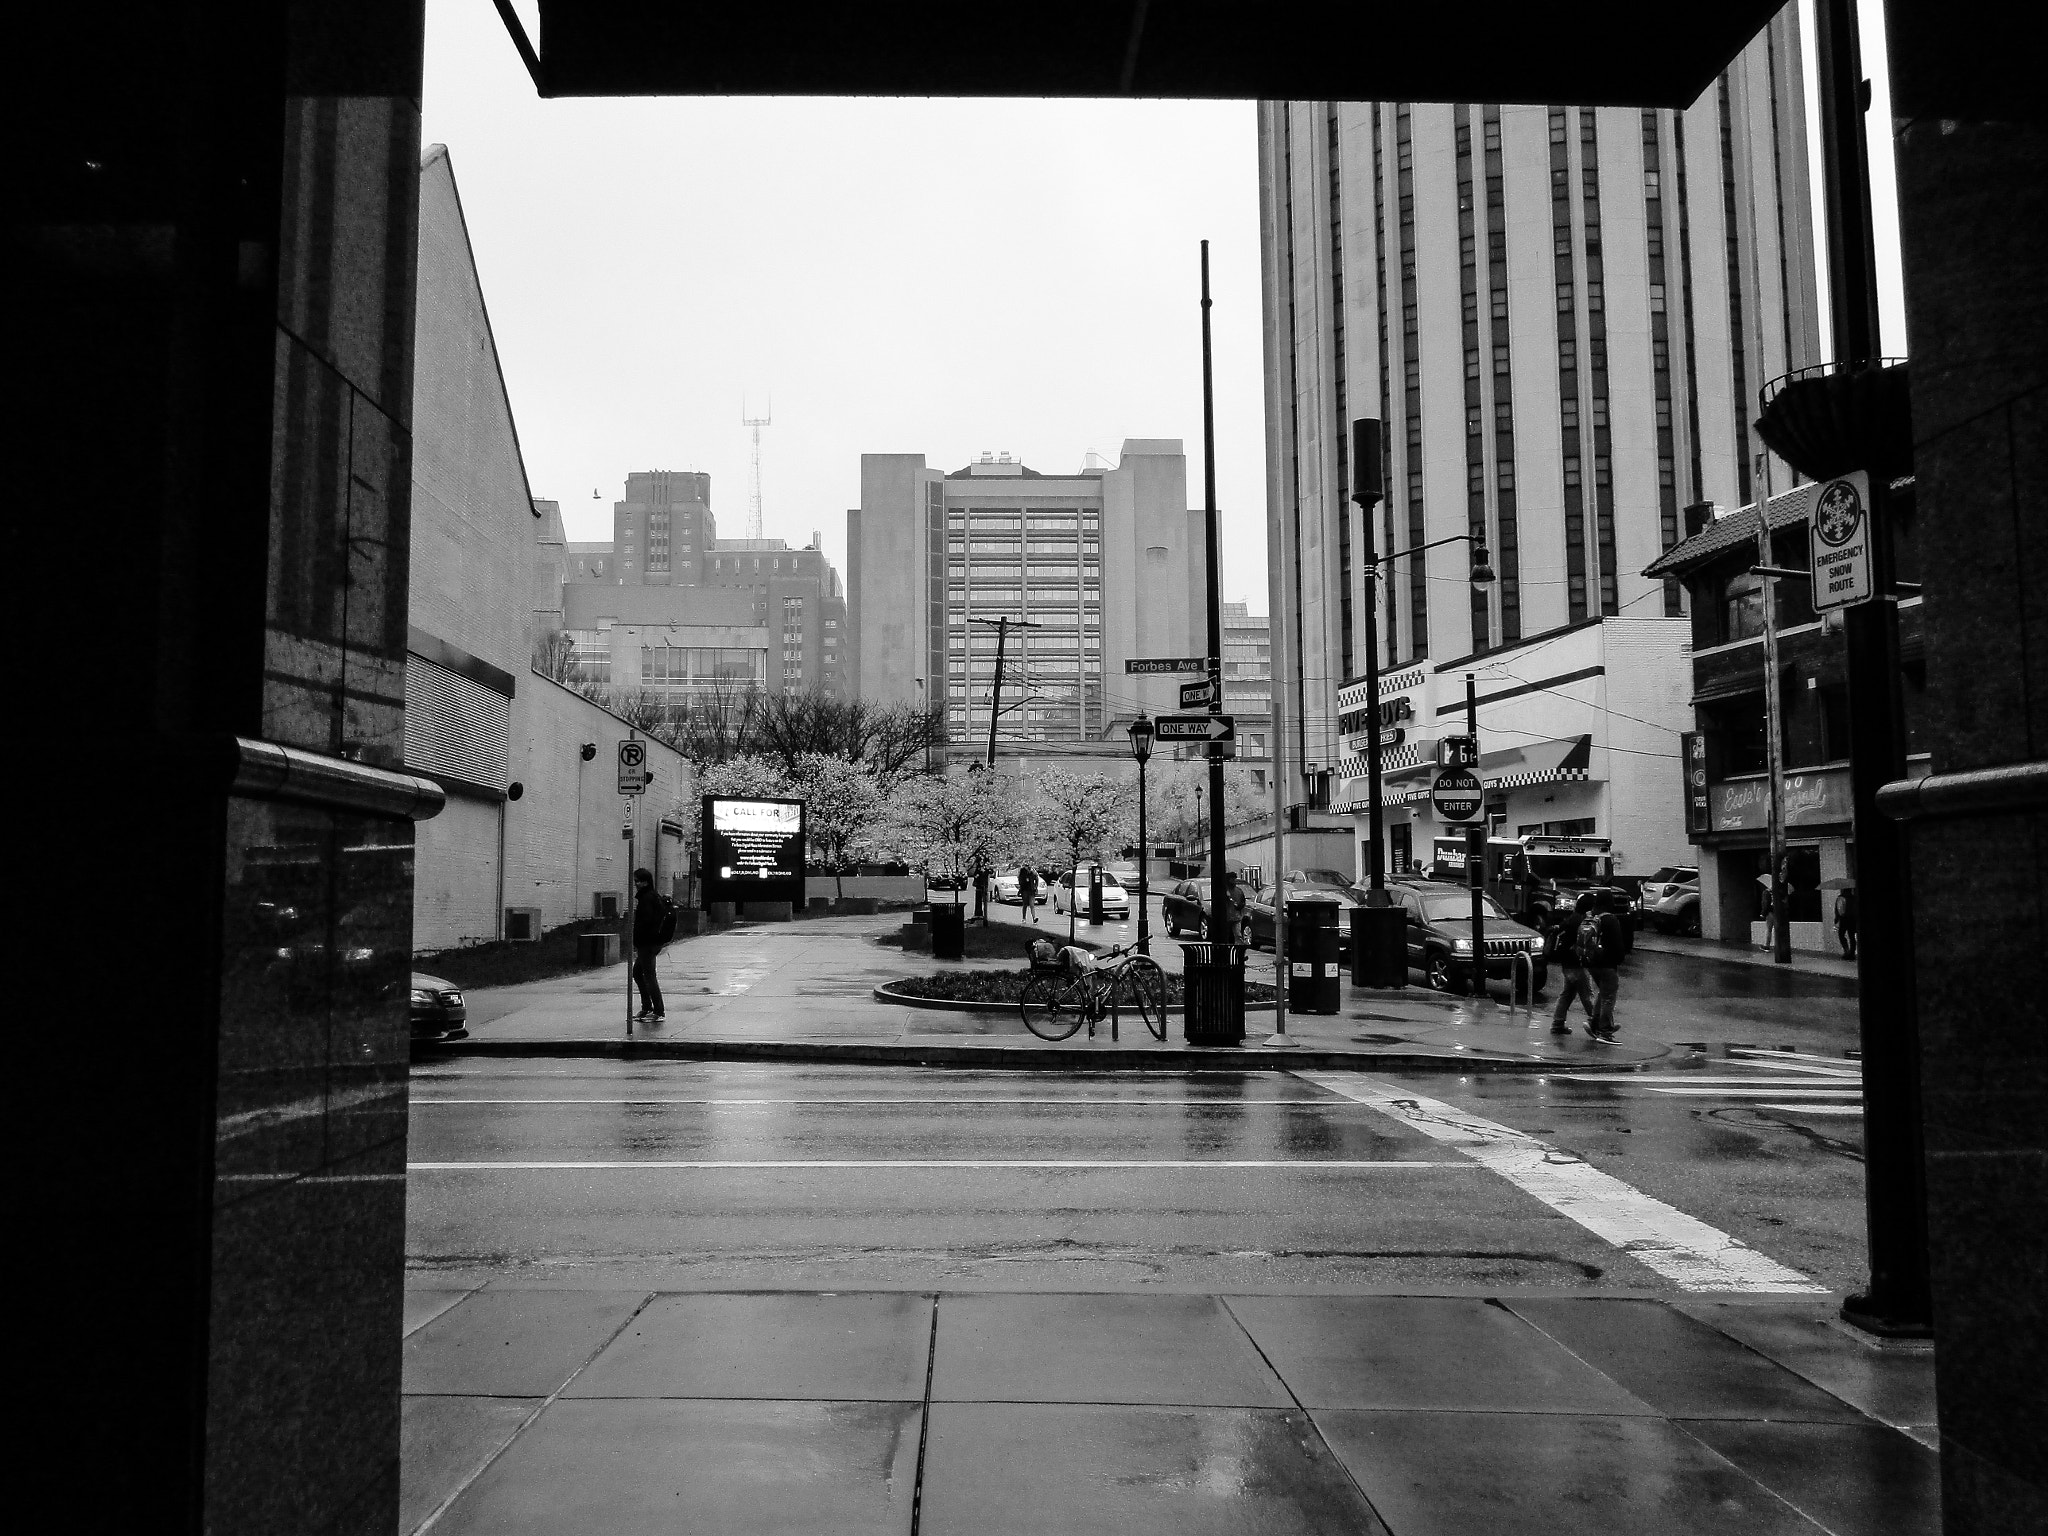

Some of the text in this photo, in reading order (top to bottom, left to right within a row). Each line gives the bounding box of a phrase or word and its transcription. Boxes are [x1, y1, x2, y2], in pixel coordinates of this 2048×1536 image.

[1817, 545, 1863, 567] EMERGENCY
[1829, 563, 1852, 578] SNOW
[1829, 577, 1854, 593] ROUTE
[1130, 660, 1198, 671] Forbes Ave
[1184, 690, 1200, 701] ONE
[1339, 696, 1411, 735] FIVE UYS
[1162, 723, 1209, 734] ONE WAY
[1439, 779, 1475, 788] DO NOT
[1407, 791, 1430, 801] FIVE GUYS
[1443, 802, 1473, 811] ENTER
[733, 808, 780, 817] CALL FOR
[1437, 847, 1467, 862] Dunbar
[1548, 844, 1586, 854] Dunbar
